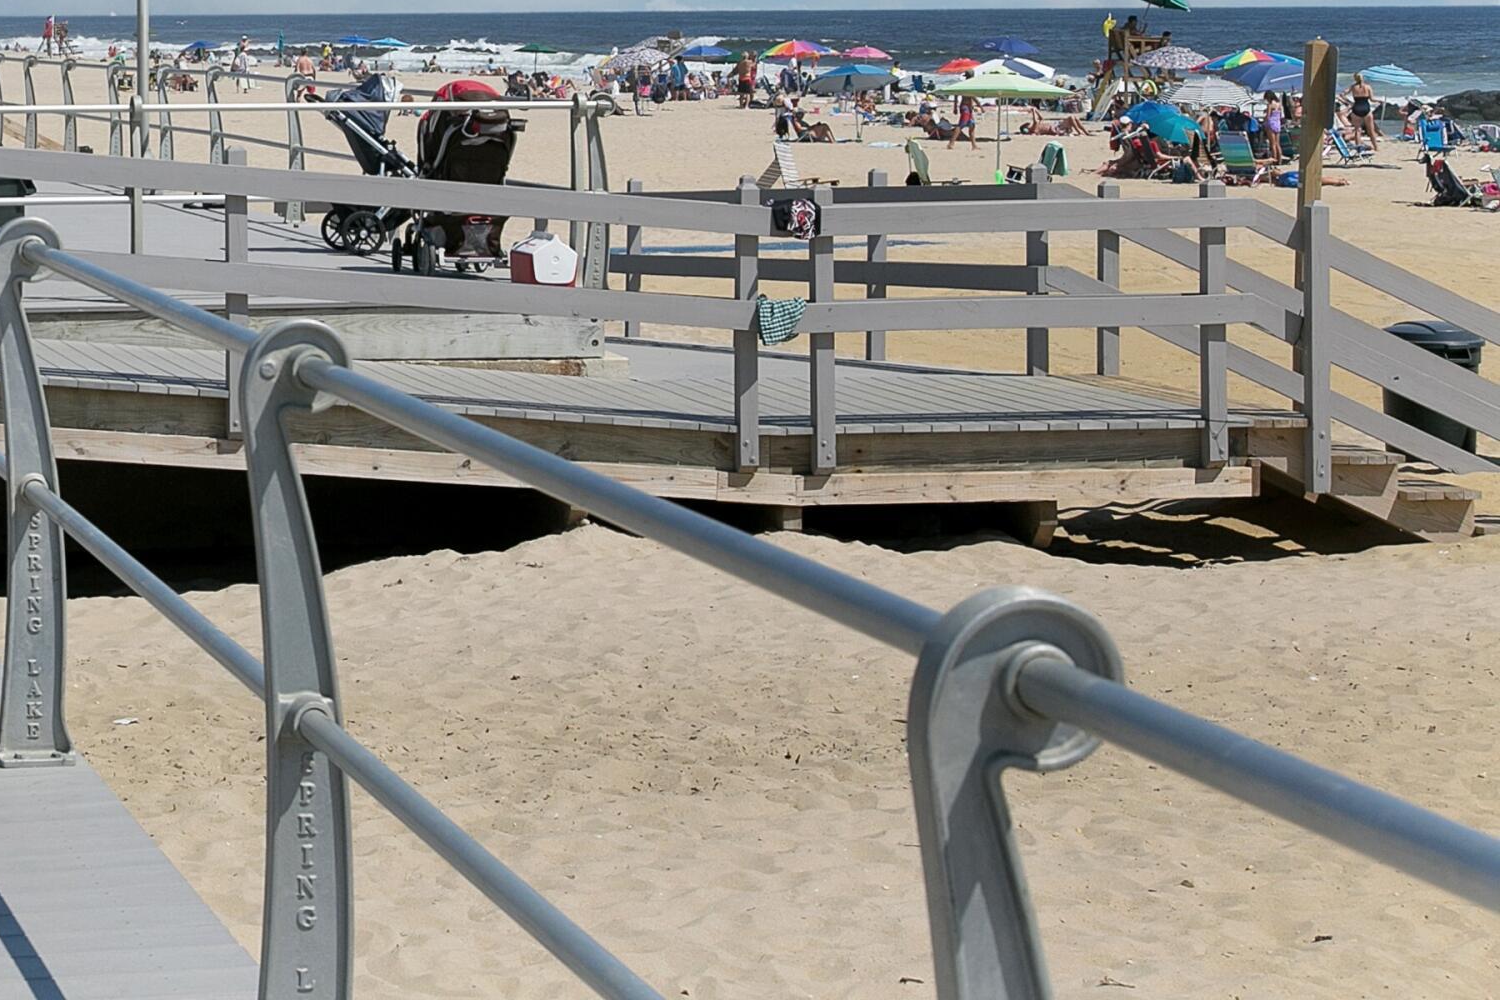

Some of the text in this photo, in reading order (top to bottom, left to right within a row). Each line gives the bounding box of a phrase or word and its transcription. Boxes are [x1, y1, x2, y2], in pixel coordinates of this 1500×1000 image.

[25, 511, 43, 741] SPRING LAKE
[296, 751, 319, 932] SPRING
